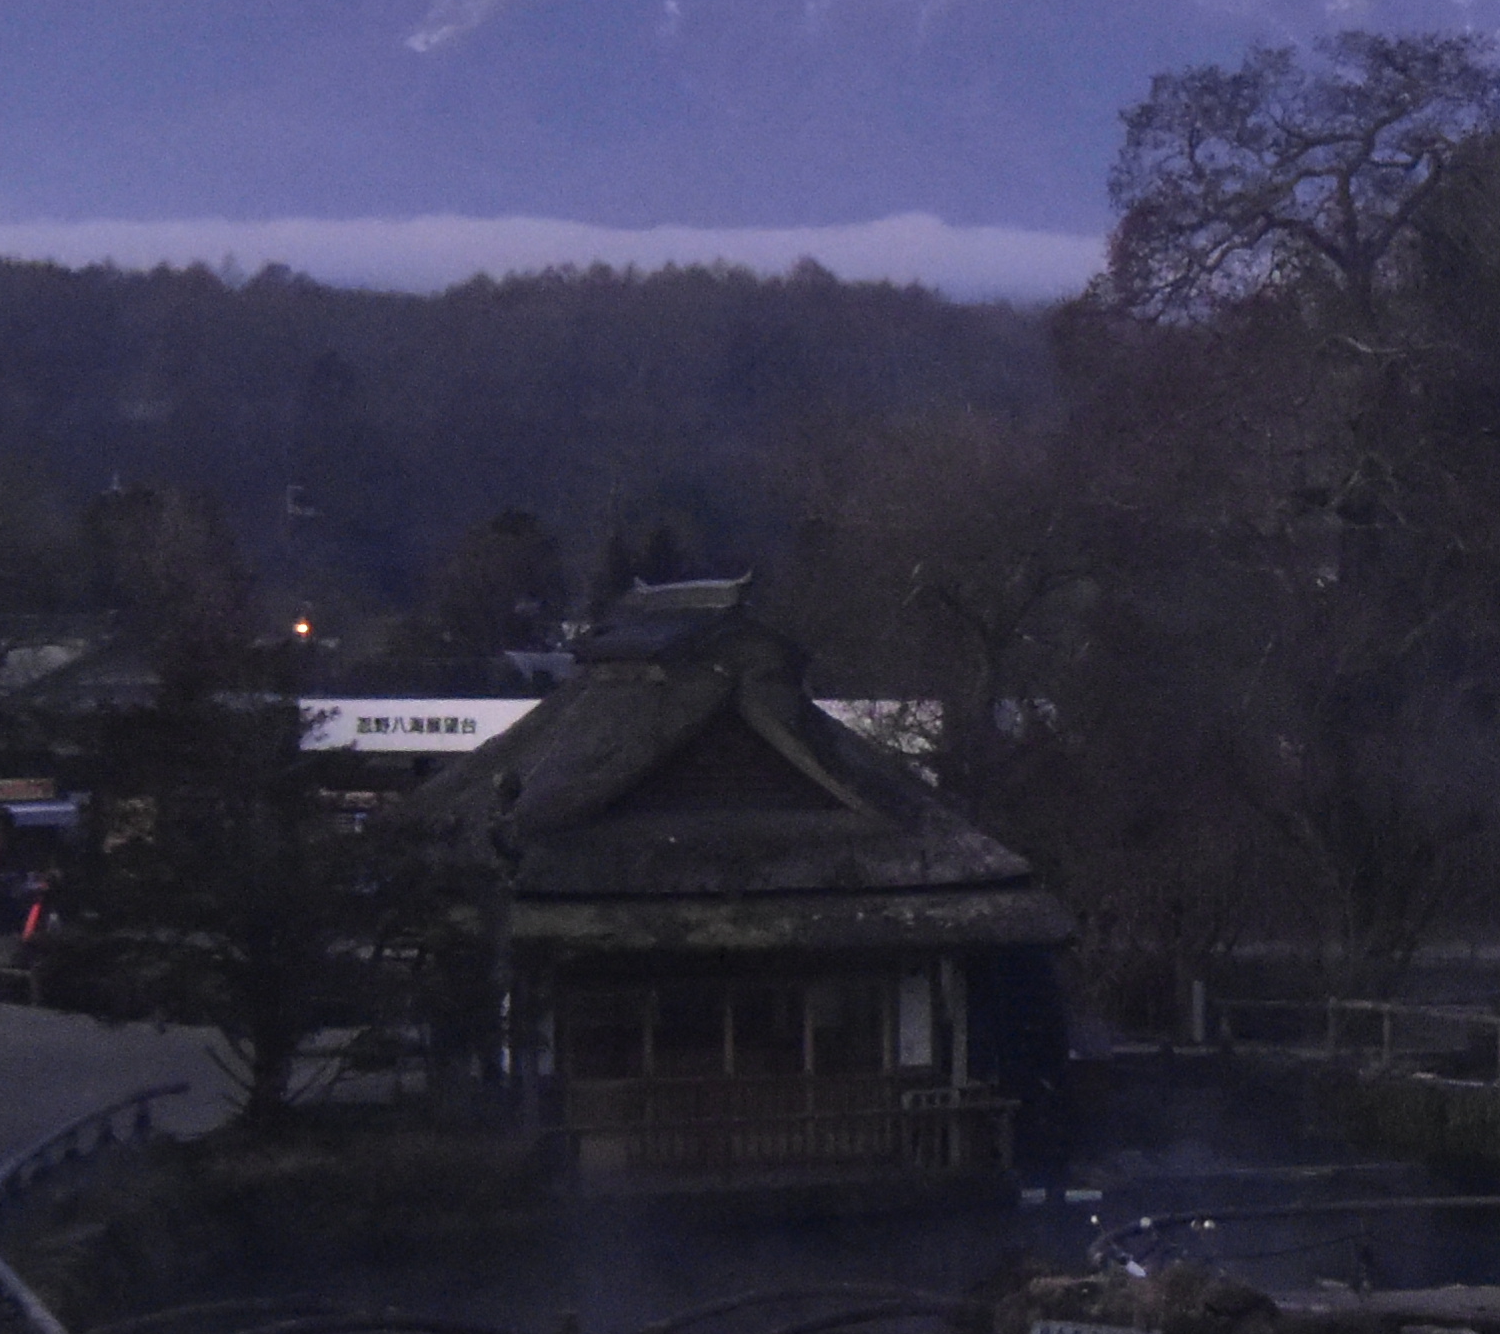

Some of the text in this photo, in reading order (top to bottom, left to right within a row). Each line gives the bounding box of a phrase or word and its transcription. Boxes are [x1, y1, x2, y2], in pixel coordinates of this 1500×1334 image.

[356, 716, 477, 734] 忍野八海展望台
